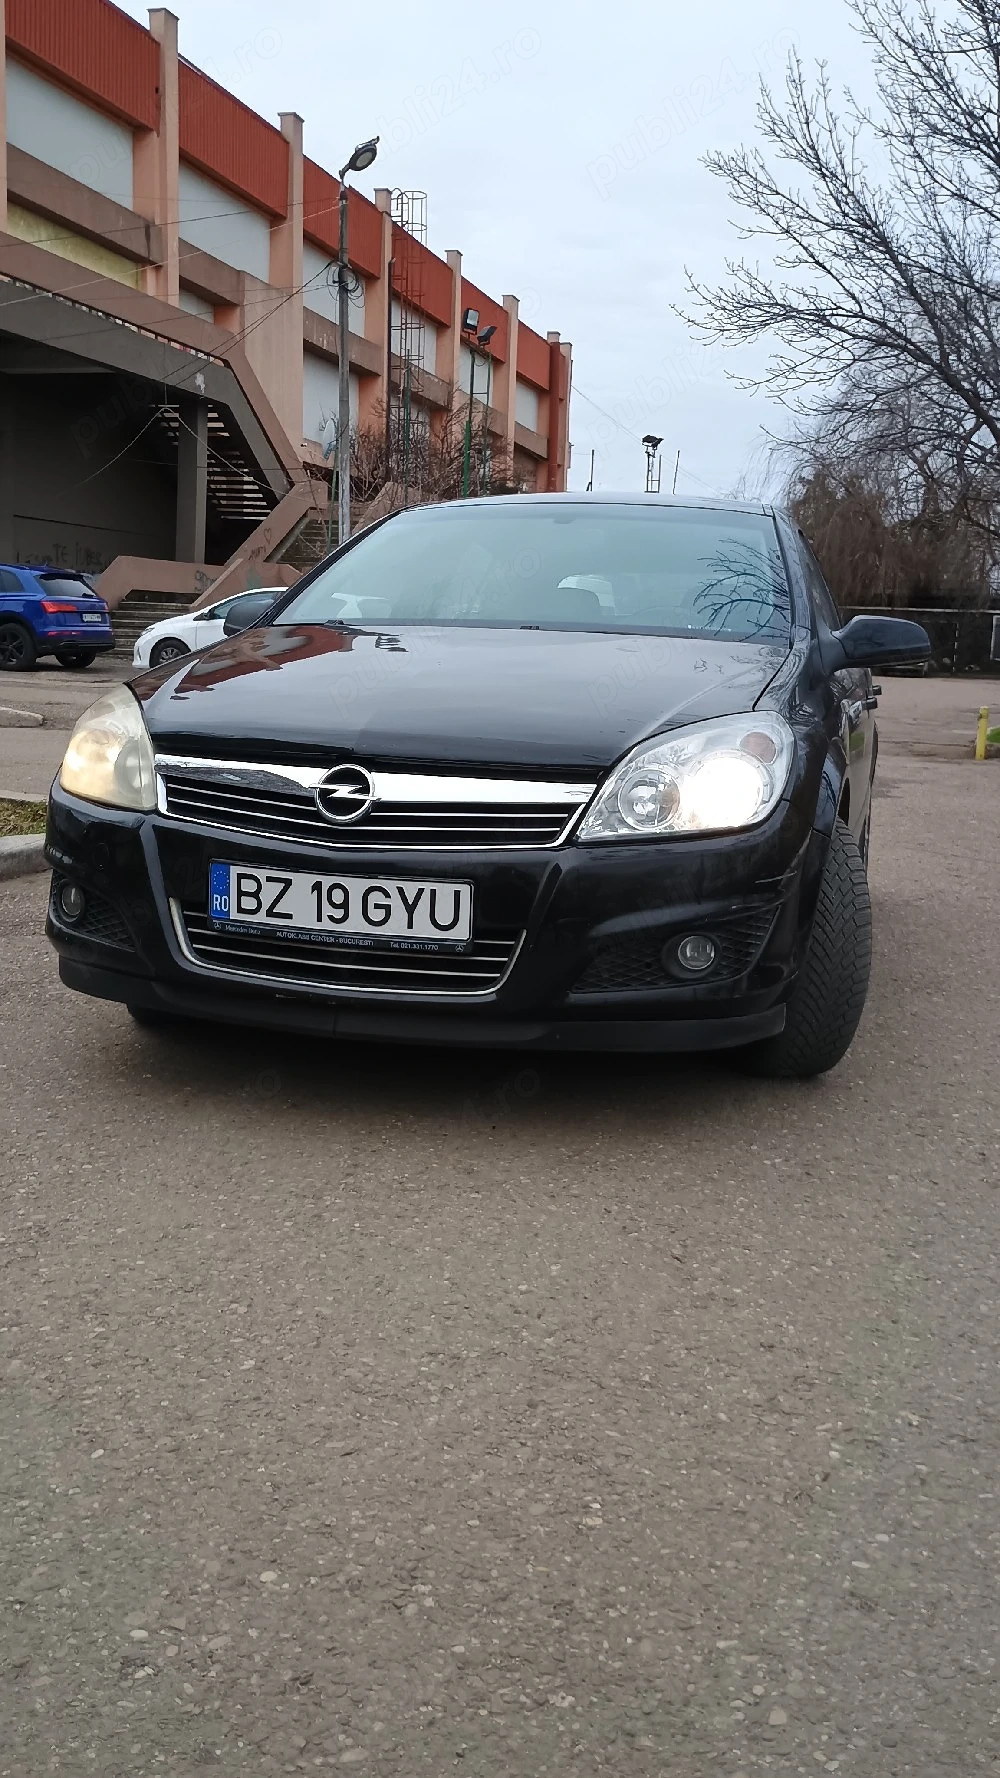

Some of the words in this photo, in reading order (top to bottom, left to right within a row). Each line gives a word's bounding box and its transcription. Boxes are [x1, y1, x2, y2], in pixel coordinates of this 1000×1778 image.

[213, 894, 229, 912] RO
[236, 872, 294, 920] BZ
[310, 880, 350, 924] 19
[361, 885, 462, 932] GYU
[310, 934, 335, 943] CENTER
